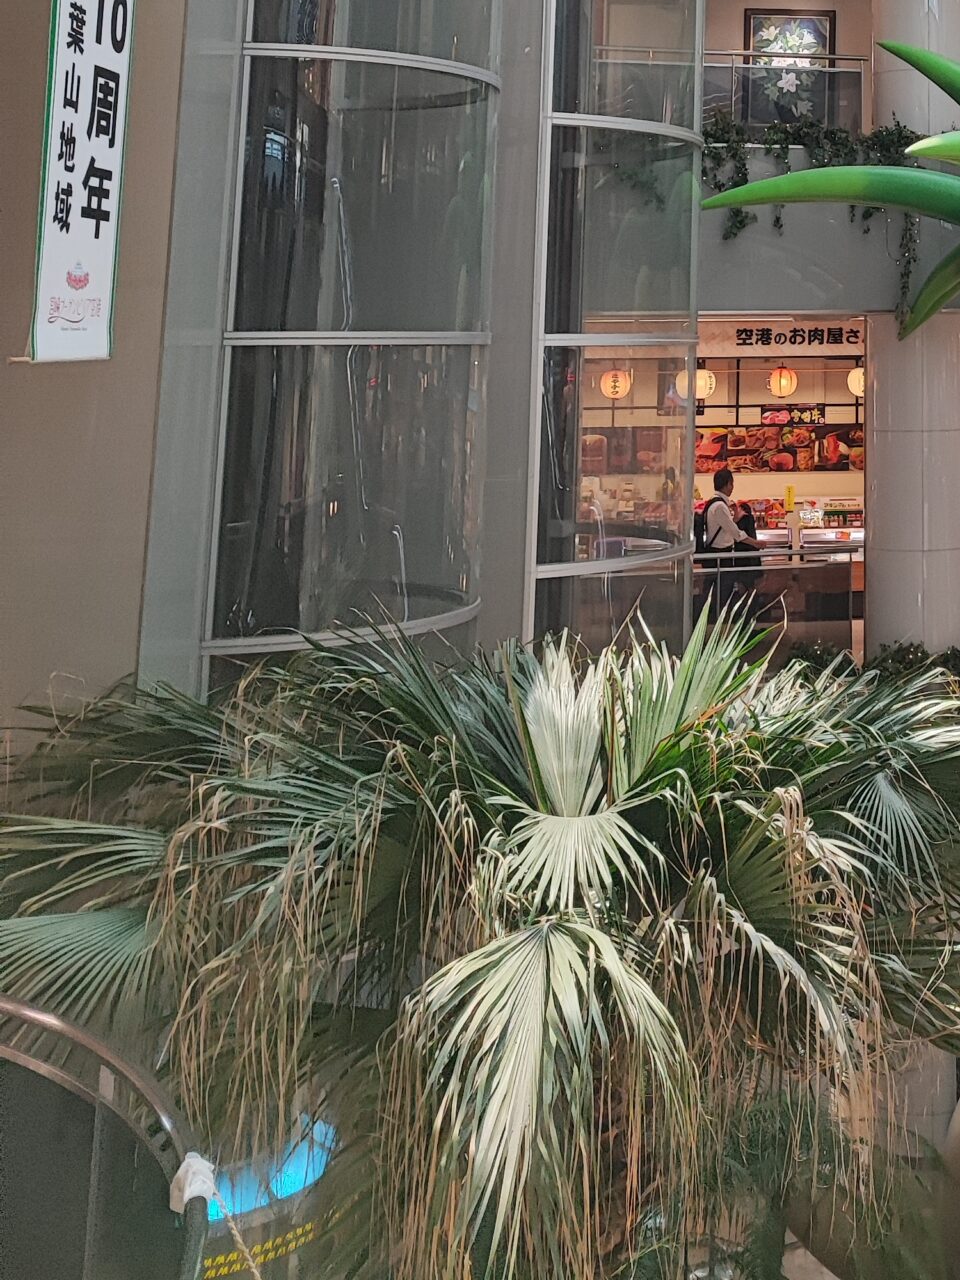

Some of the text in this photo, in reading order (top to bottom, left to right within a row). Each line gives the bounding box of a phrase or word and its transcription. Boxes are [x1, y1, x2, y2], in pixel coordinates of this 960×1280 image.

[736, 323, 864, 346] 空港のお肉屋さ
